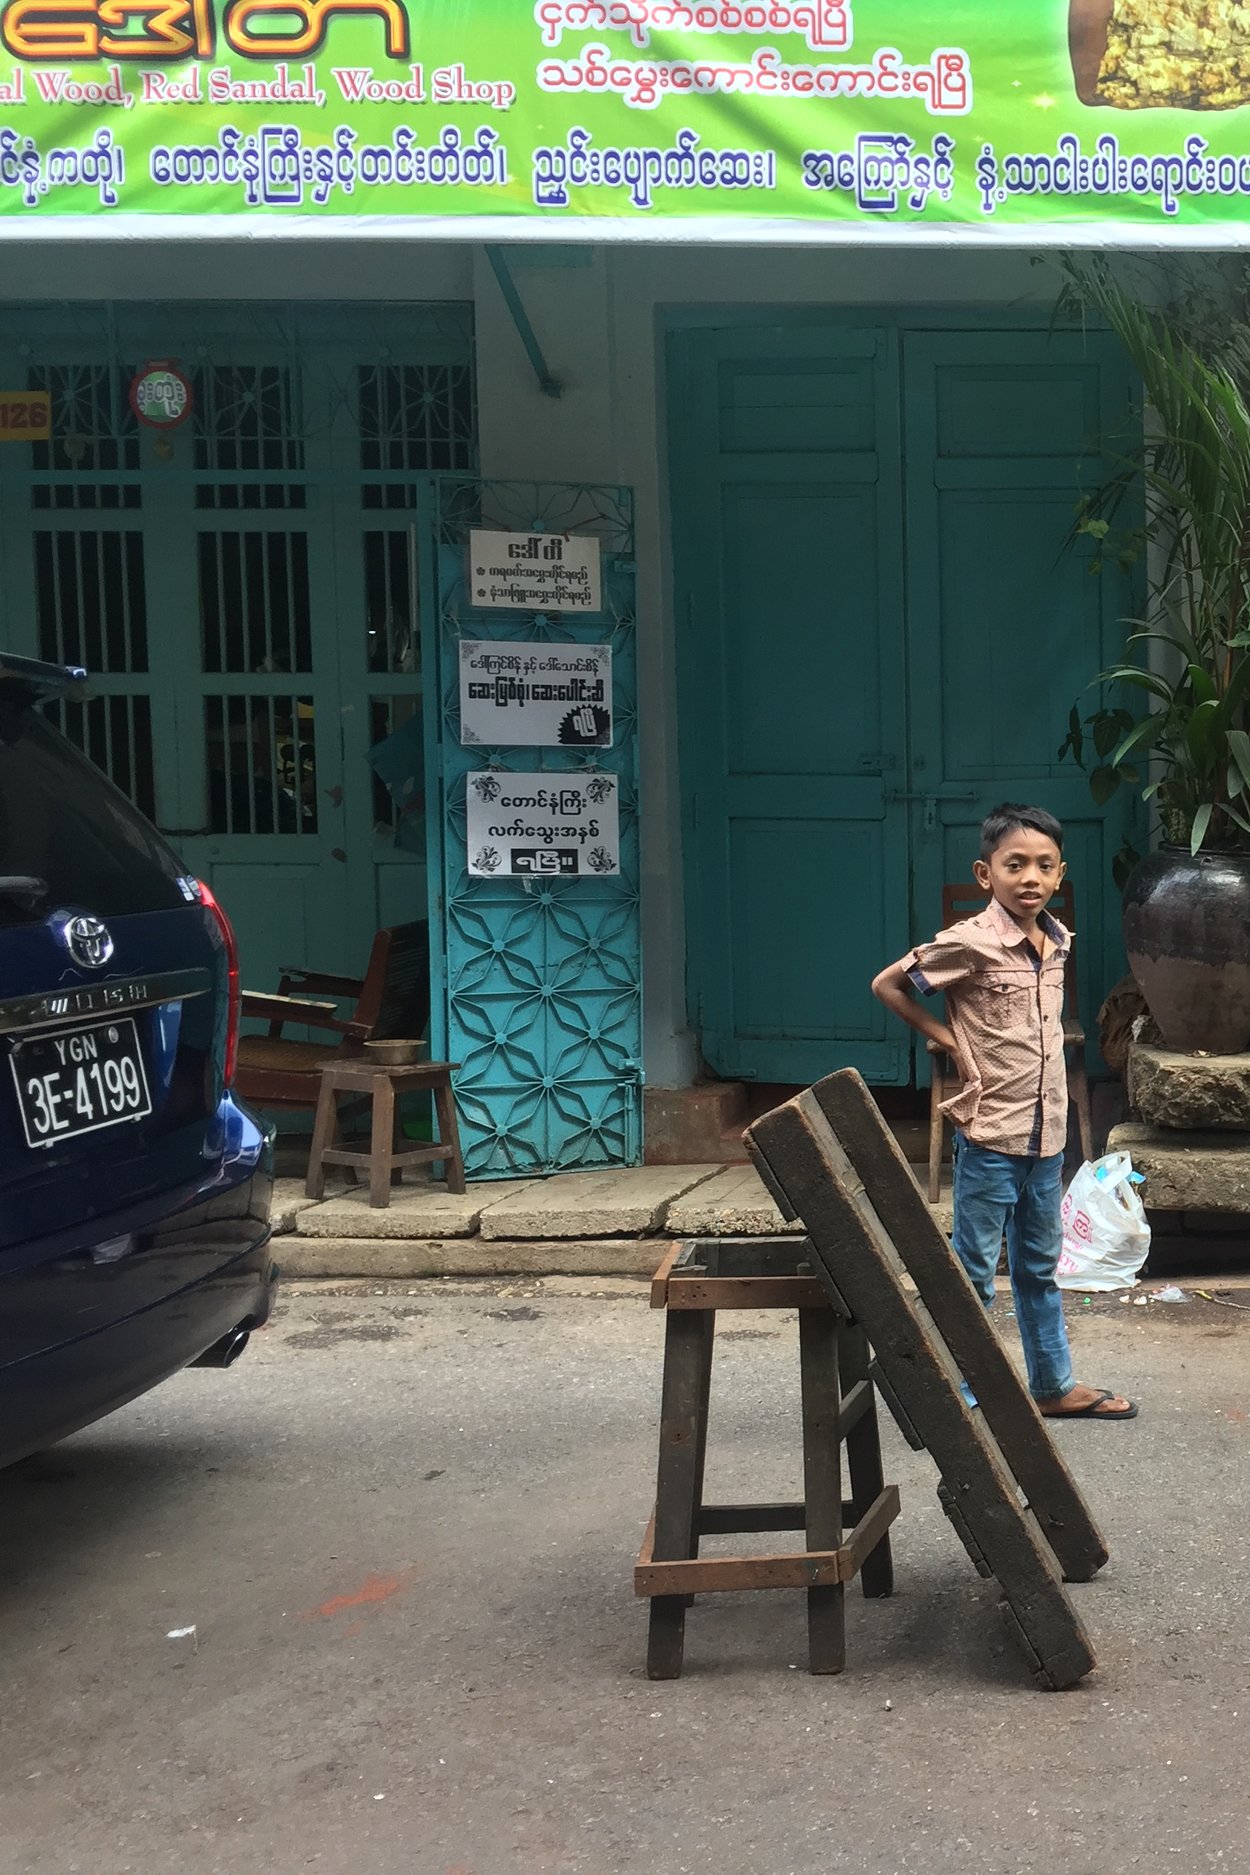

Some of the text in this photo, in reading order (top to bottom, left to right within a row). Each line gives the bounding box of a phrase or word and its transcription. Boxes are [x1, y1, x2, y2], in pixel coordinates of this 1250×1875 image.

[34, 66, 133, 104] Wood,
[142, 66, 200, 100] Red
[210, 64, 324, 104] Sandal,
[334, 65, 423, 99] Wood
[433, 65, 514, 106] Shop
[54, 1033, 98, 1066] YGN
[28, 1056, 142, 1135] 3E-4199
